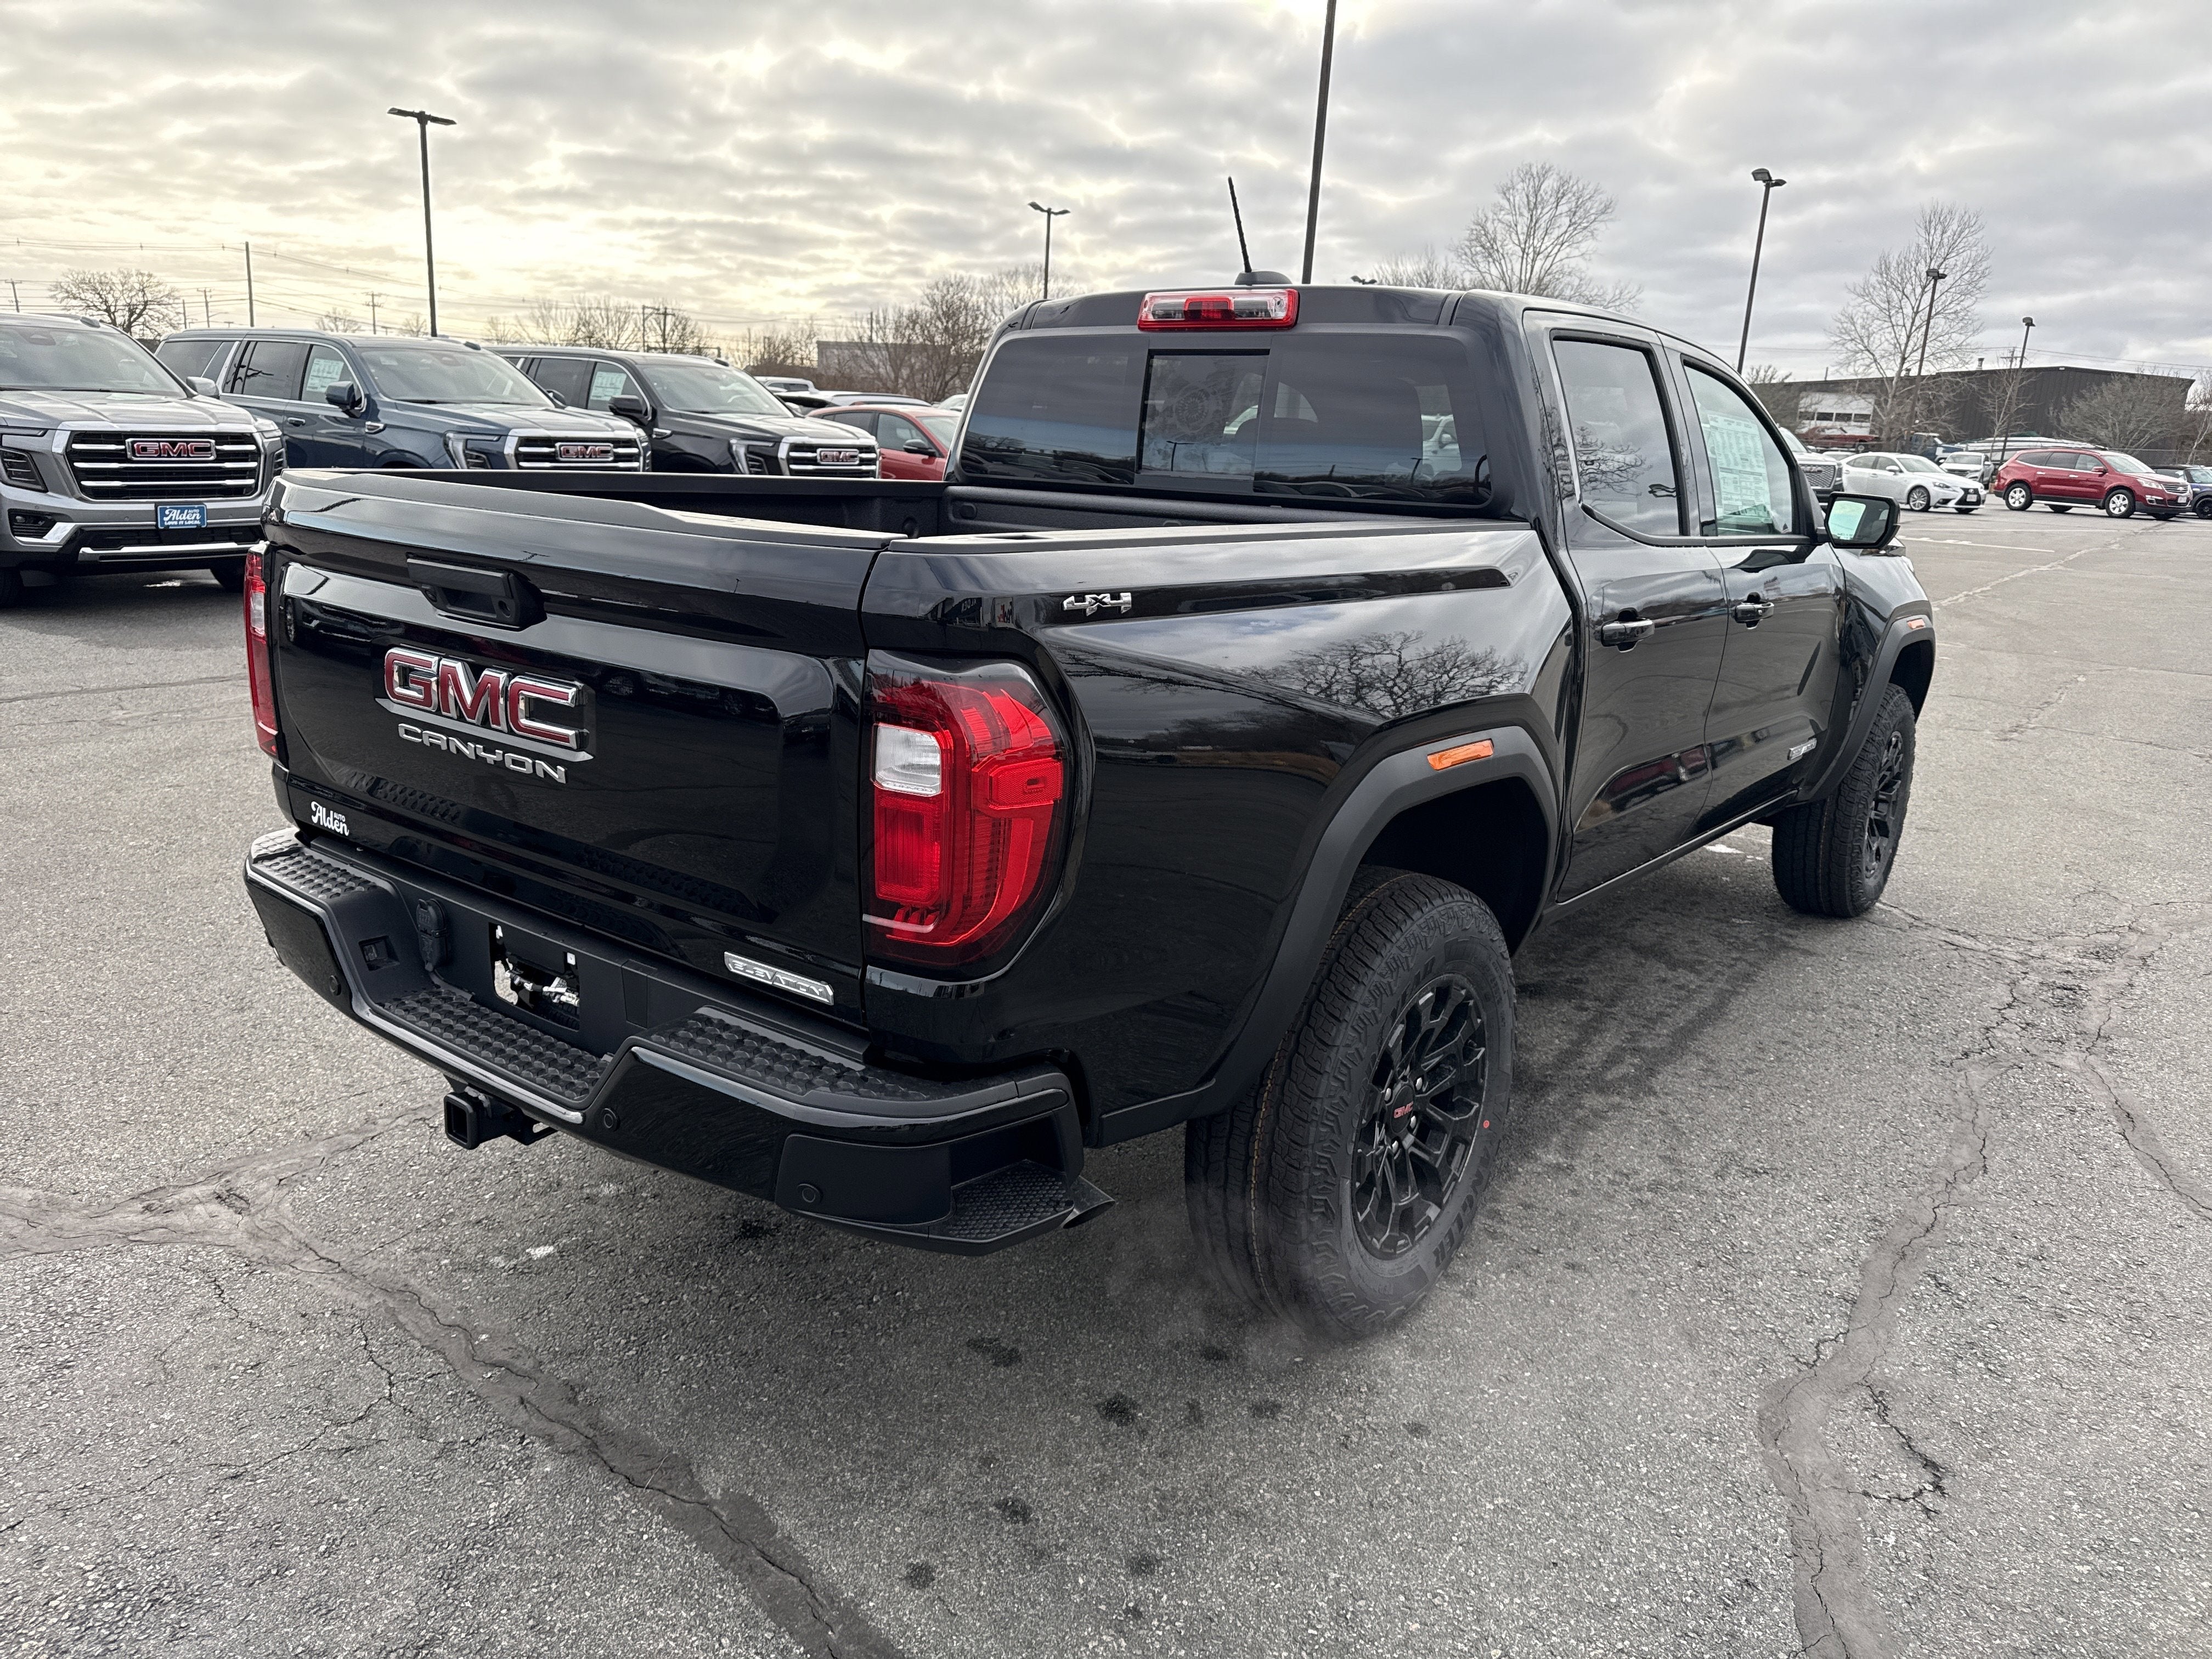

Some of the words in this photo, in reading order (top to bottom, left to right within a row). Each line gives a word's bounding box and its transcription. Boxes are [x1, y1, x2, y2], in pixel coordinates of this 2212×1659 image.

[134, 442, 212, 457] GMC
[561, 445, 611, 458] GMC
[821, 451, 857, 462] GMC
[163, 509, 201, 521] Alden
[384, 646, 590, 751] GMC
[398, 723, 568, 784] CANYON
[311, 801, 349, 836] Alden
[334, 812, 346, 822] AUTO
[731, 960, 825, 997] ELEVATION
[1393, 1101, 1414, 1119] GMC
